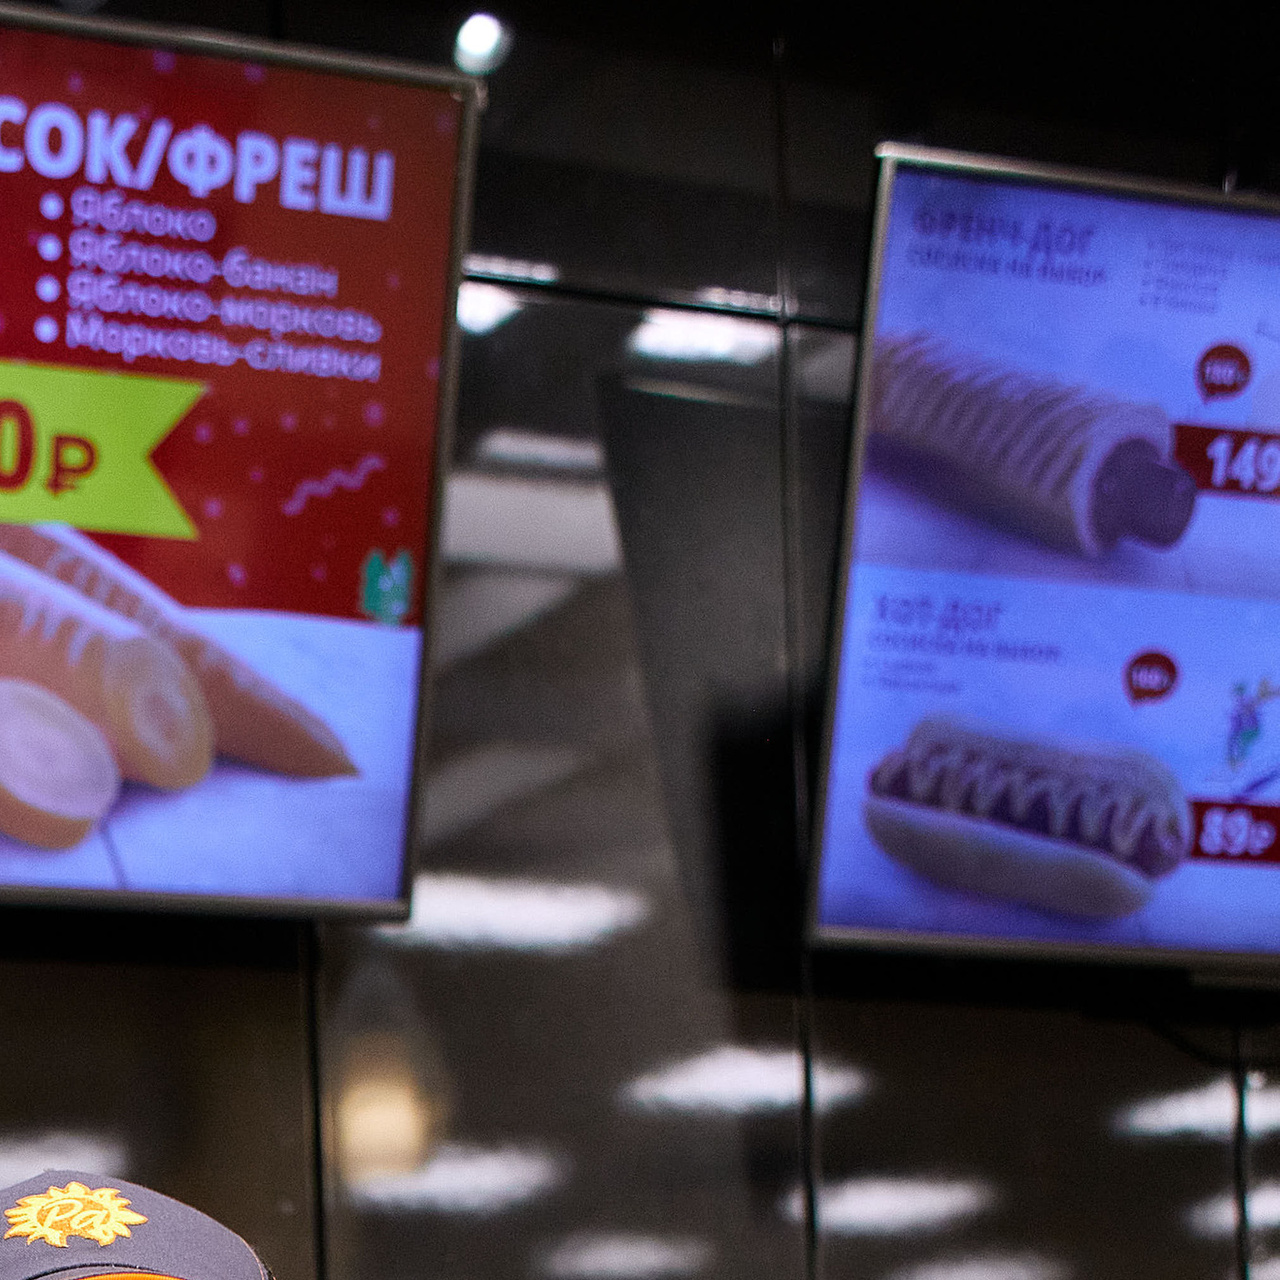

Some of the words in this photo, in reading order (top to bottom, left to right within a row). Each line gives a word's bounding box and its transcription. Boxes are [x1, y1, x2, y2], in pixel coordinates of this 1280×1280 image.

[70, 186, 217, 242] Яблоко
[69, 227, 339, 298] Яблоко-банан
[67, 268, 383, 343] Яблоко-морковь
[65, 311, 382, 383] Морковь-сливки
